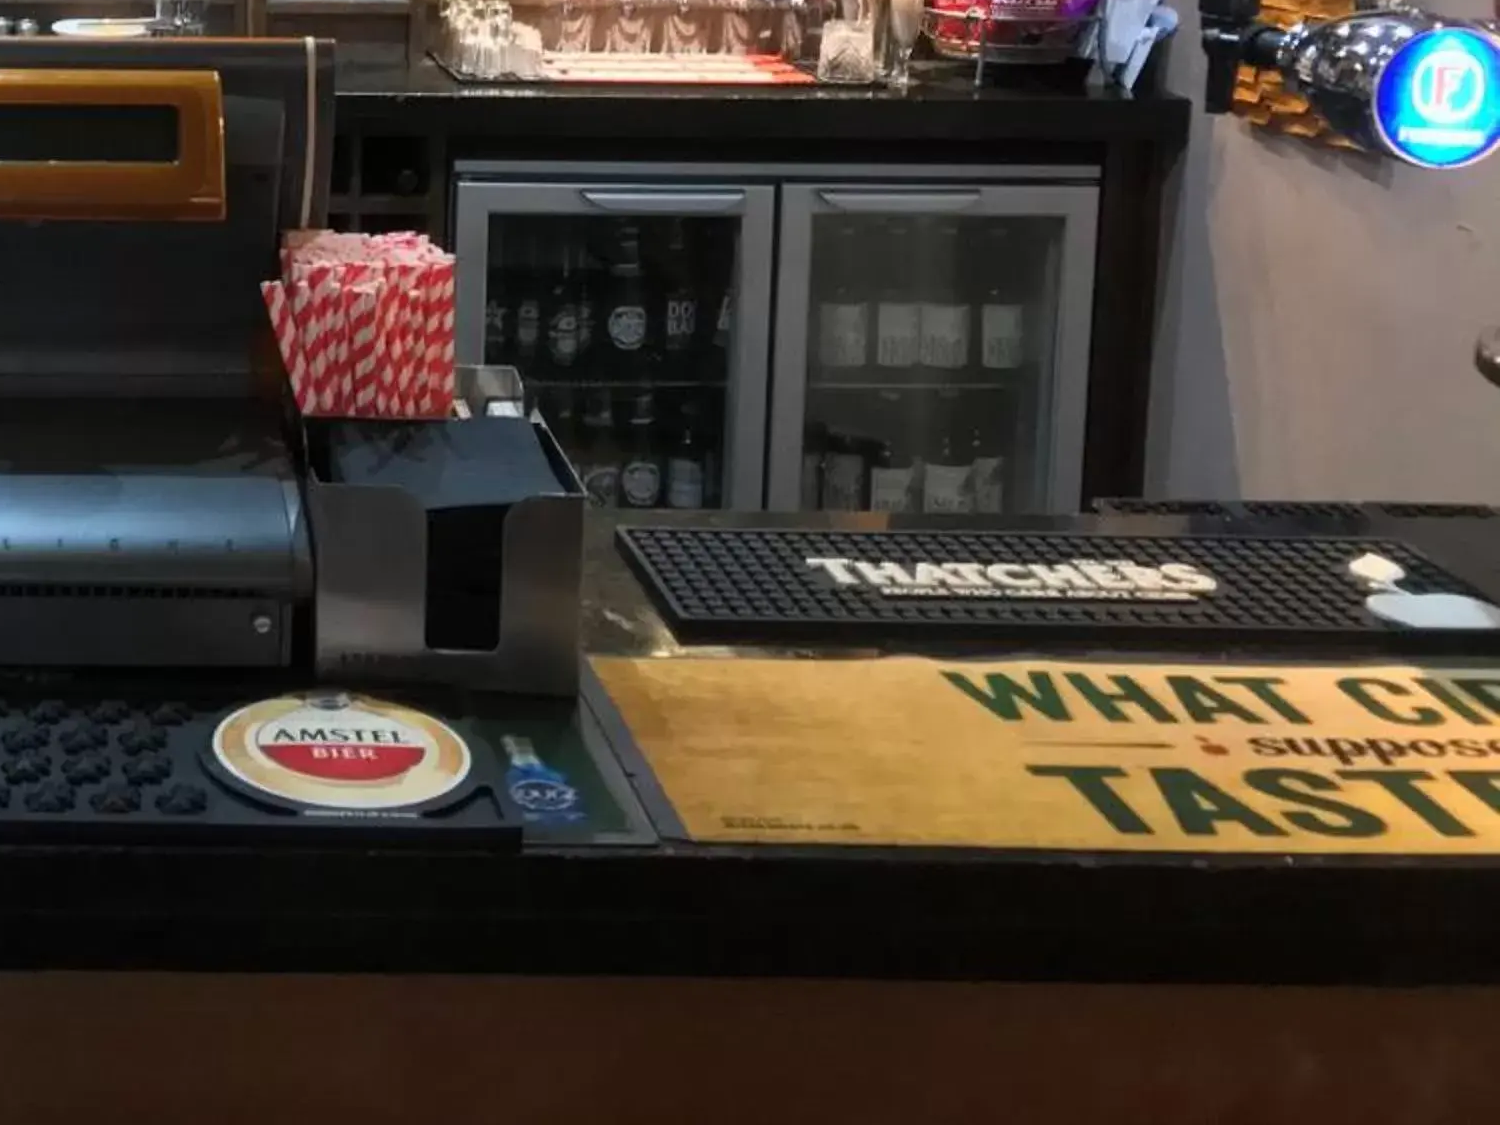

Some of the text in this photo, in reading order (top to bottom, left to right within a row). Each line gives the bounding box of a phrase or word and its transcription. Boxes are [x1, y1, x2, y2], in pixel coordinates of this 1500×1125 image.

[806, 557, 1218, 591] THATCHERS
[938, 670, 1314, 726] WHAT
[272, 728, 409, 744] AMSTEL
[311, 746, 378, 761] BIER
